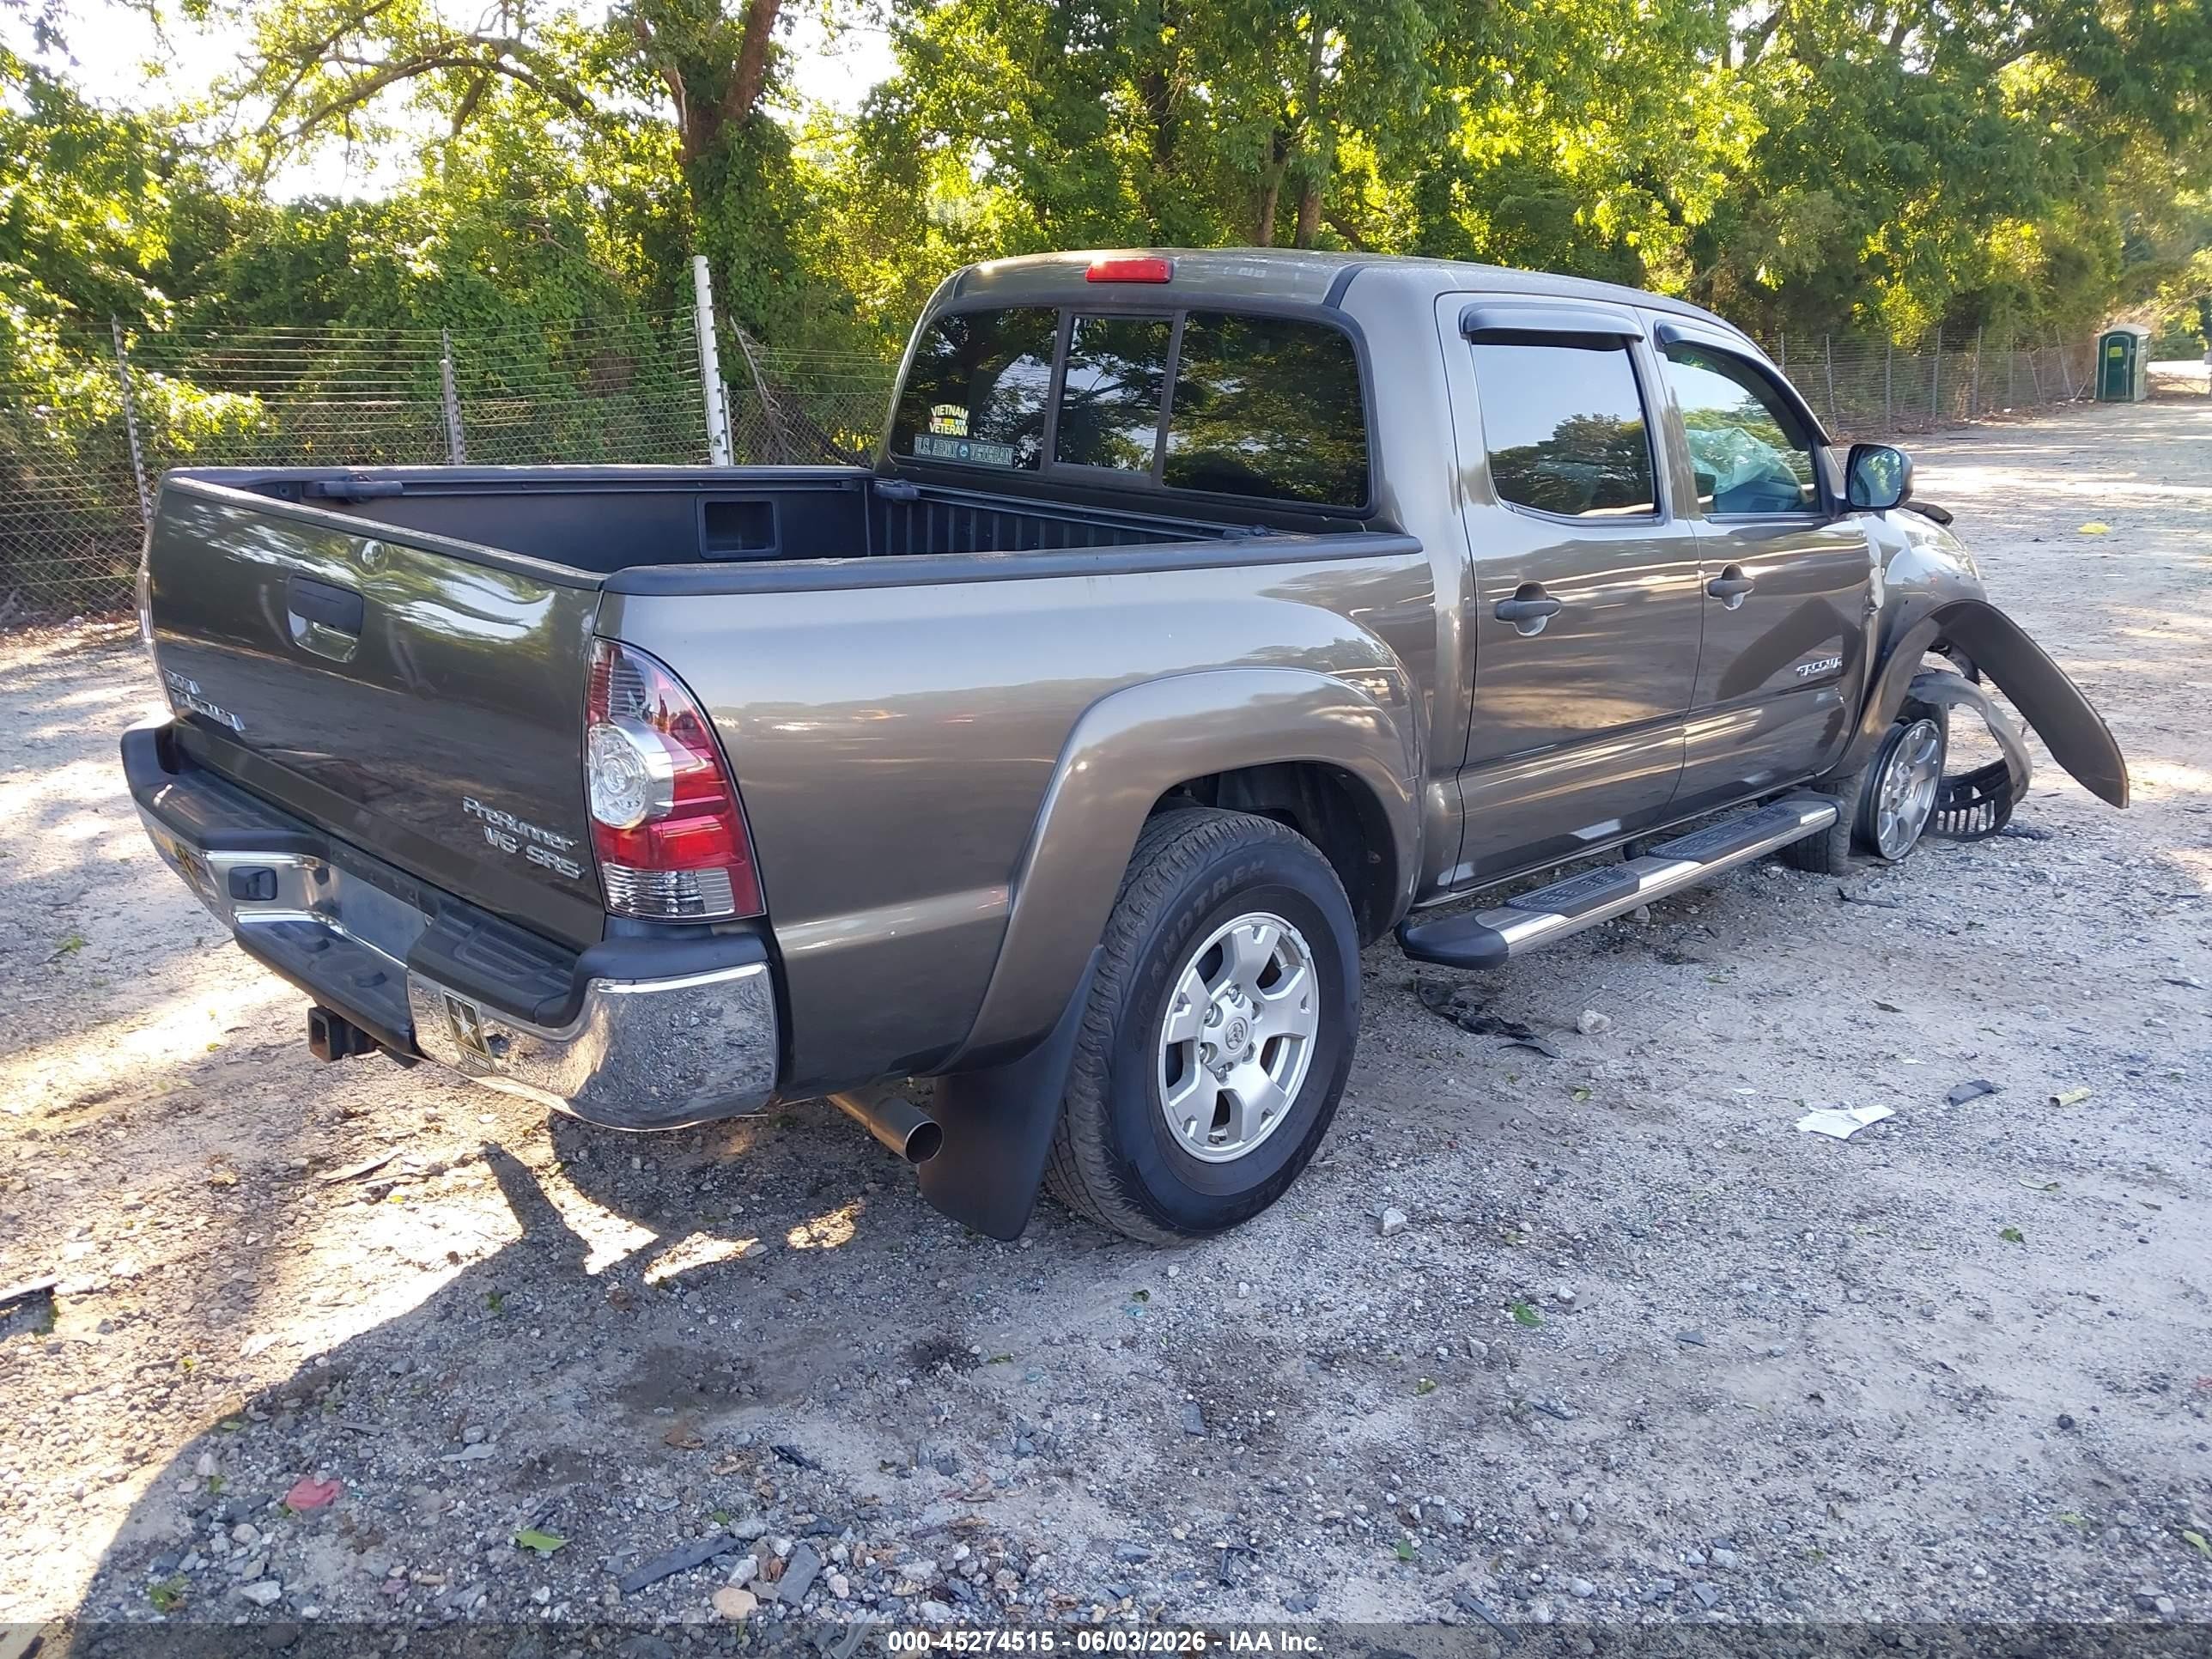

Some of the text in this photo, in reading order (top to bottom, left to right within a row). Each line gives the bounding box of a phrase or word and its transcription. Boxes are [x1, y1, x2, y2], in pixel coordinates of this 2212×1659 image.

[930, 404, 969, 420] VIETNAM
[928, 422, 969, 436] VETERAN
[915, 436, 1014, 465] U.S. ARMY VETERAN
[462, 795, 578, 852] PreRunner
[483, 824, 520, 854] V6
